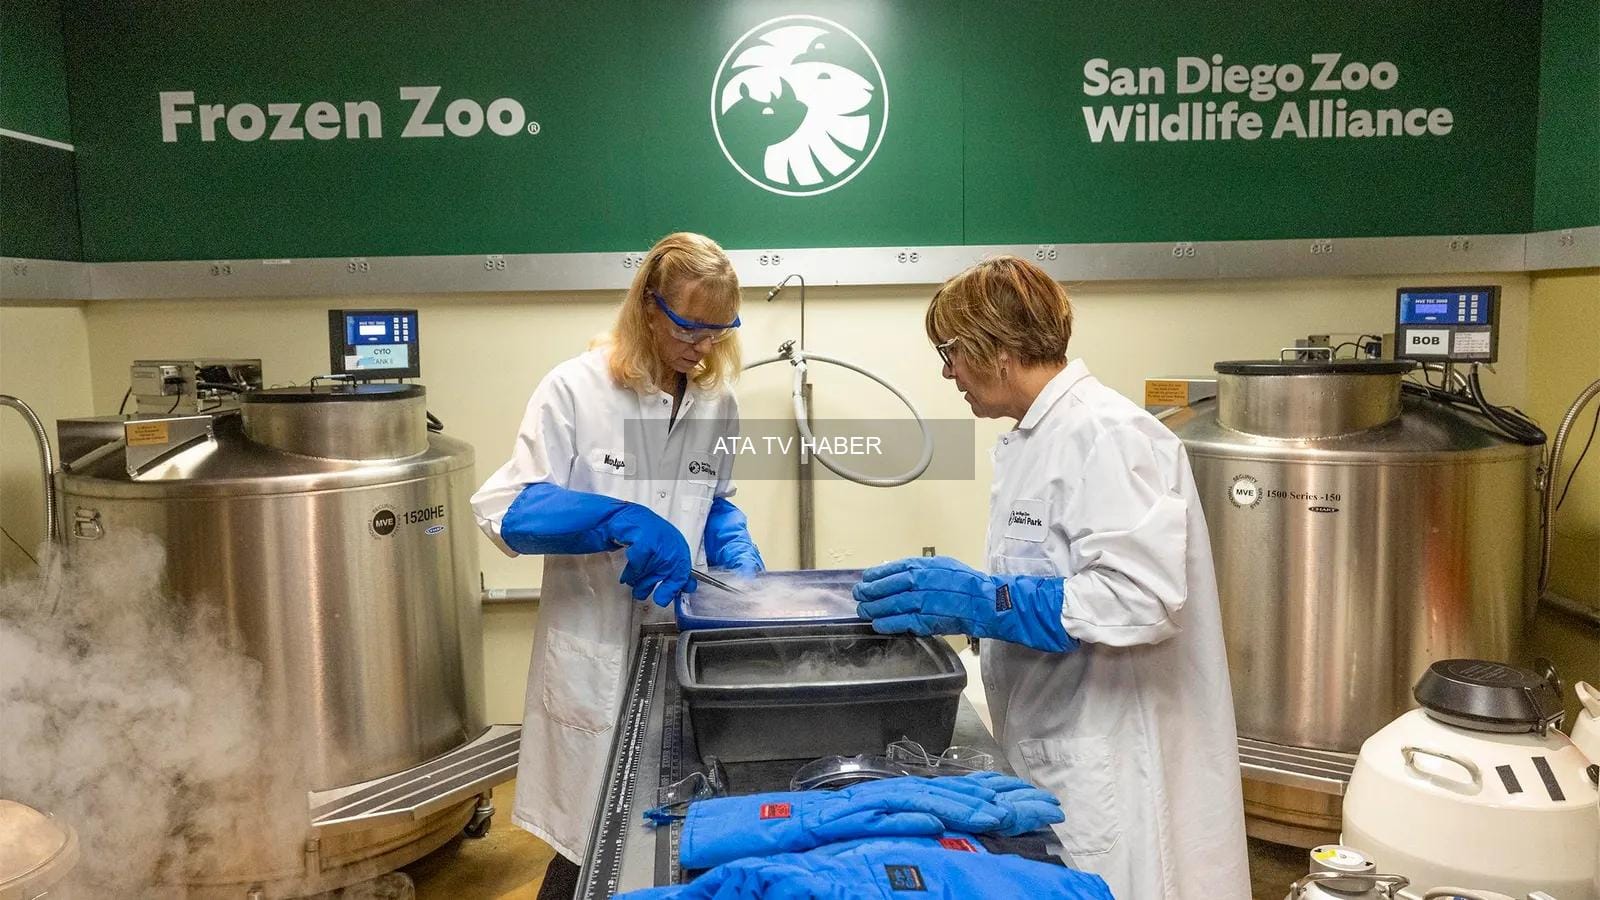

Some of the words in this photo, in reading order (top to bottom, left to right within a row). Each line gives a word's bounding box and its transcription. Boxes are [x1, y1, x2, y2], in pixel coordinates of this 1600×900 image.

[1082, 57, 1165, 97] San
[1176, 54, 1305, 102] Diego
[1309, 52, 1399, 91] Zoo
[159, 90, 383, 143] Frozen
[1081, 101, 1263, 143] Wildlife
[1270, 98, 1454, 139] Alliance
[1412, 336, 1440, 345] BOB
[1235, 488, 1254, 497] MVE
[1267, 489, 1288, 499] 1500
[1289, 490, 1318, 501] Series
[403, 504, 445, 525] 1520HE
[375, 518, 394, 528] MVE
[1027, 517, 1042, 526] Park
